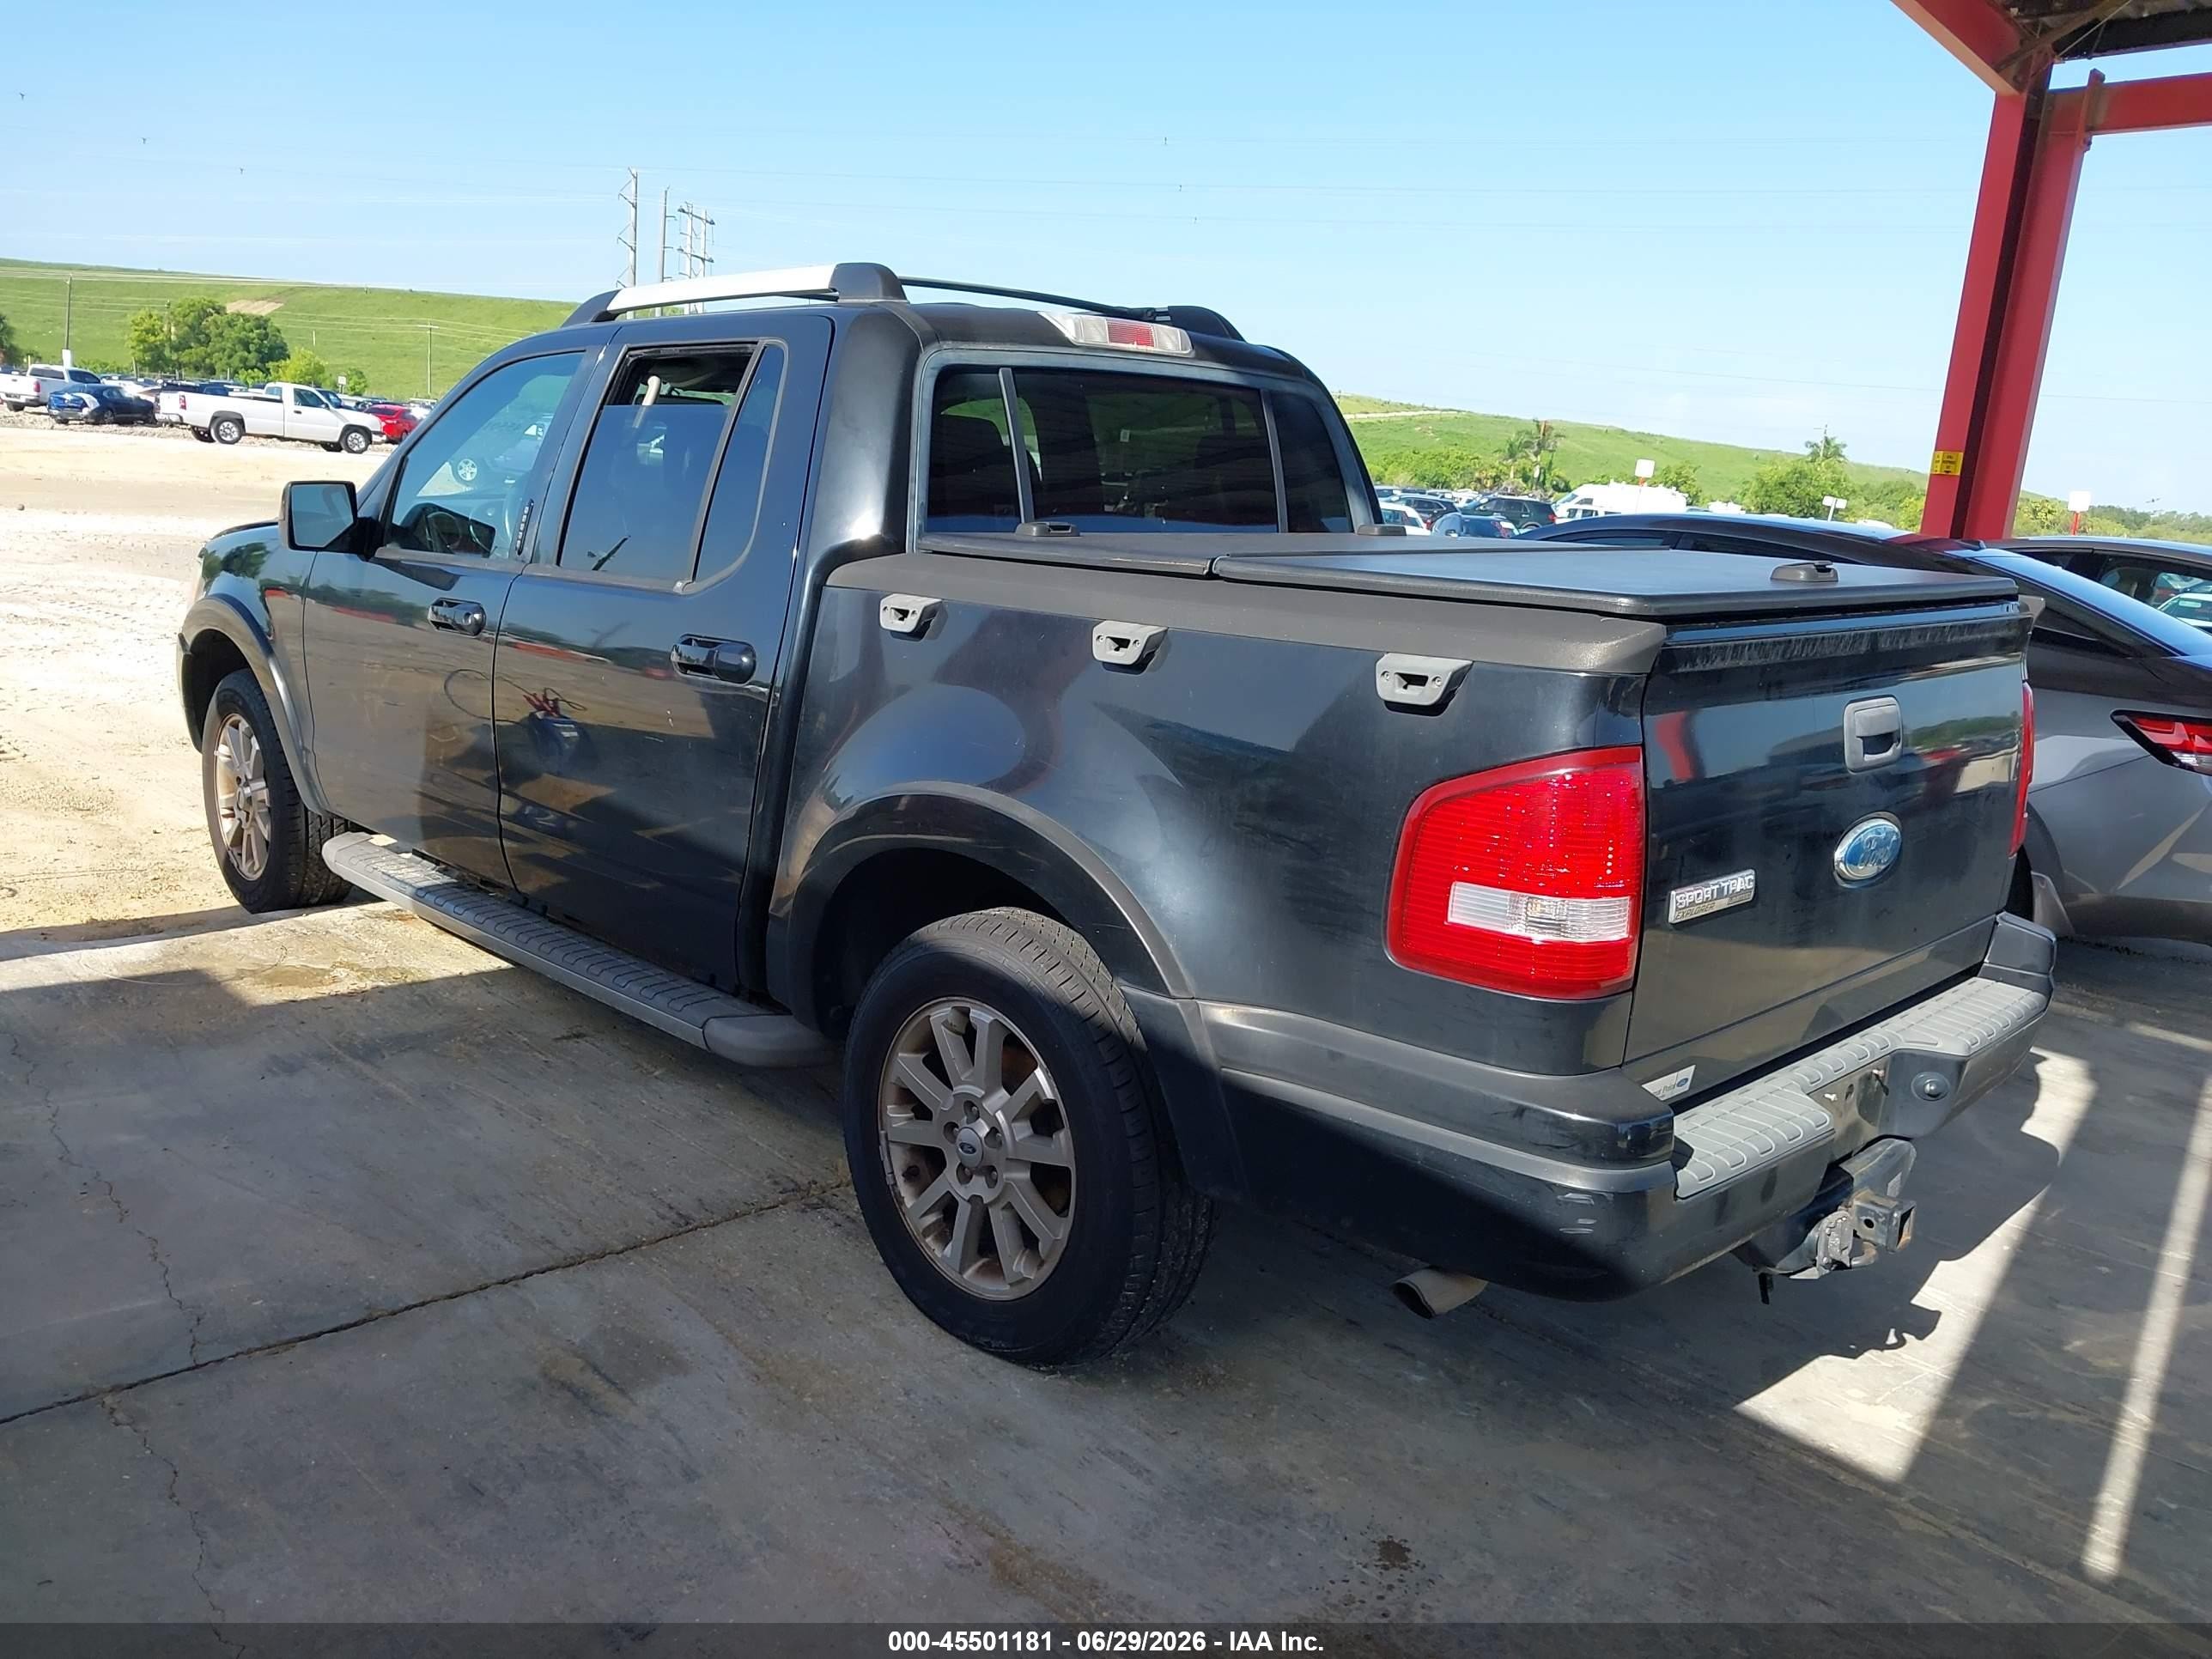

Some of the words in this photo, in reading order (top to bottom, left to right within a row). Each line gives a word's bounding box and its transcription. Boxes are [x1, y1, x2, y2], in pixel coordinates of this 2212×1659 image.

[1675, 884, 1719, 909] SPORT
[1720, 874, 1754, 896] TRAC
[1675, 901, 1717, 921] EXPLORER
